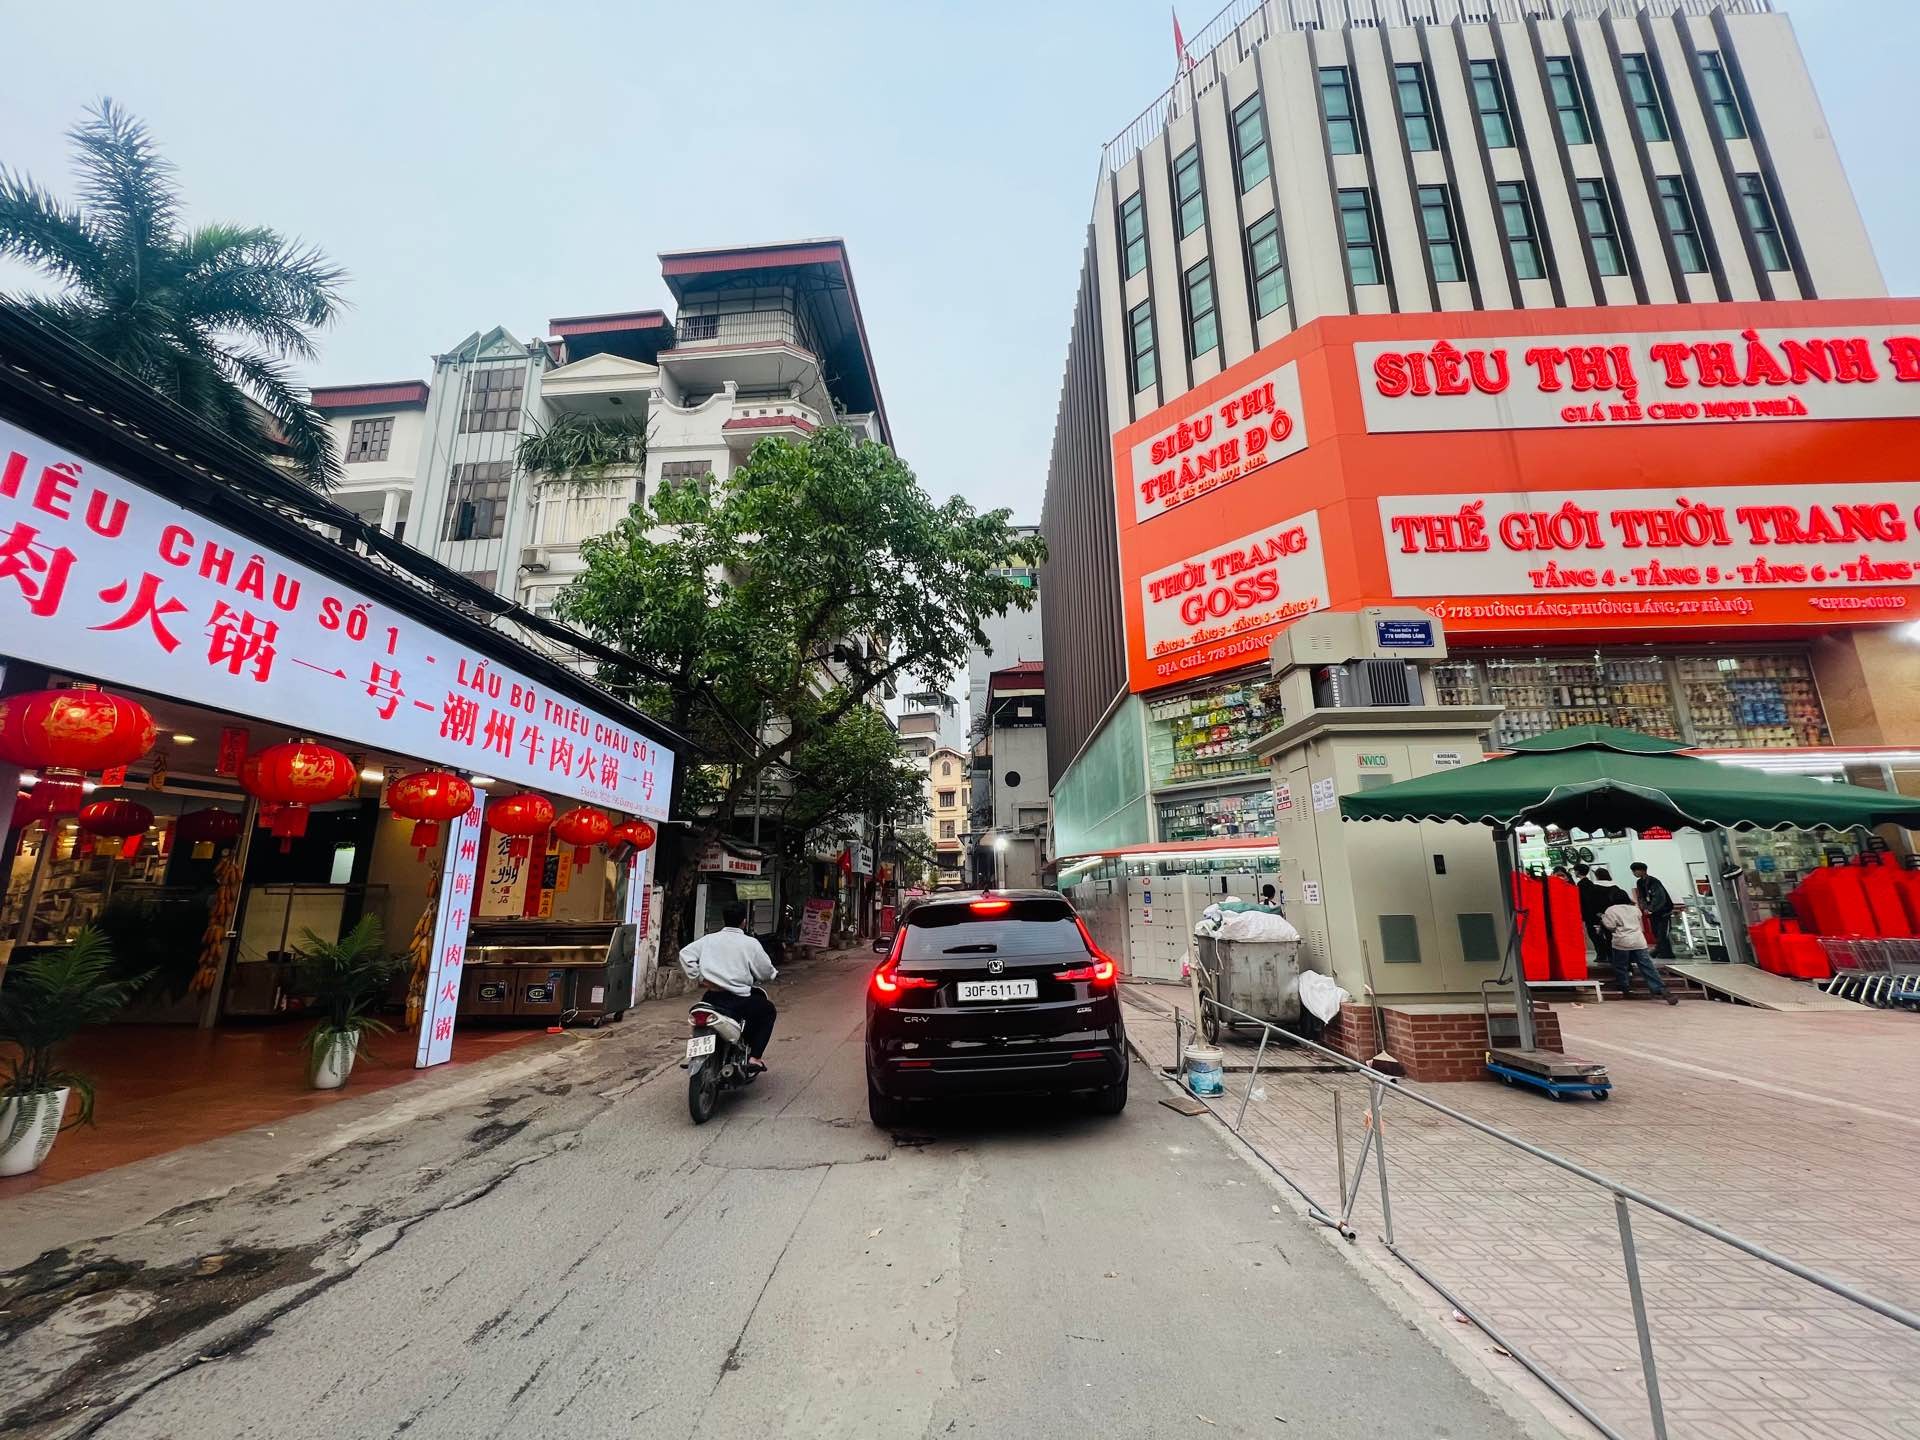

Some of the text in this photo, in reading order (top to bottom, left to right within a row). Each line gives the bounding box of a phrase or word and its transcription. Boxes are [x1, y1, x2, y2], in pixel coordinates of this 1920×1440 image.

[1374, 339, 1511, 397] SIÊU
[1526, 345, 1640, 401] THỊ
[1651, 328, 1879, 388] THÀNH
[1150, 380, 1276, 466] SIÊU THỊ
[1561, 393, 1808, 423] GIÁ RẺ CHO MỌI NHÀ
[1140, 409, 1294, 504] THÀNH ĐÔ
[1198, 477, 1218, 493] CHO
[1391, 499, 1490, 553] THẾ
[1500, 499, 1606, 551] GIỚI
[1611, 496, 1733, 548] THỜI
[1736, 503, 1907, 545] TRANG
[1148, 525, 1308, 604] THỜI TRANG
[1529, 560, 1597, 588] TẦNG
[1602, 569, 1616, 586] 4
[1631, 559, 1700, 586] TẦNG
[1706, 565, 1721, 583] 5
[1736, 554, 1808, 584] TẦNG
[1811, 564, 1827, 582] 6
[1841, 553, 1913, 582] TẦNG
[1180, 567, 1280, 627] GOSS
[1425, 600, 1446, 618] SỐ
[1449, 606, 1472, 618] 778
[1472, 602, 1525, 618] ĐƯỜNG
[1681, 601, 1700, 613] TP
[159, 525, 301, 612] CHÂU
[318, 596, 373, 642] SỐ
[386, 626, 400, 656] 1
[457, 657, 502, 699] LẨU
[510, 683, 537, 714] BÒ
[544, 699, 590, 737] TRIỀU
[595, 723, 629, 754] CHÂU
[632, 737, 648, 763] SỐ
[650, 750, 656, 766] 1
[1153, 639, 1178, 656] TẦNG
[1191, 627, 1218, 645] TẦNG
[1232, 615, 1261, 633] TẦNG
[1262, 613, 1271, 624] 6
[1276, 599, 1309, 619] TẦNG
[1311, 597, 1318, 610] 7
[1157, 633, 1274, 677] ĐỊA CHỈ: 778 ĐƯỜNG
[1359, 755, 1386, 766] INVICO
[964, 983, 1030, 997] 30F-611.17
